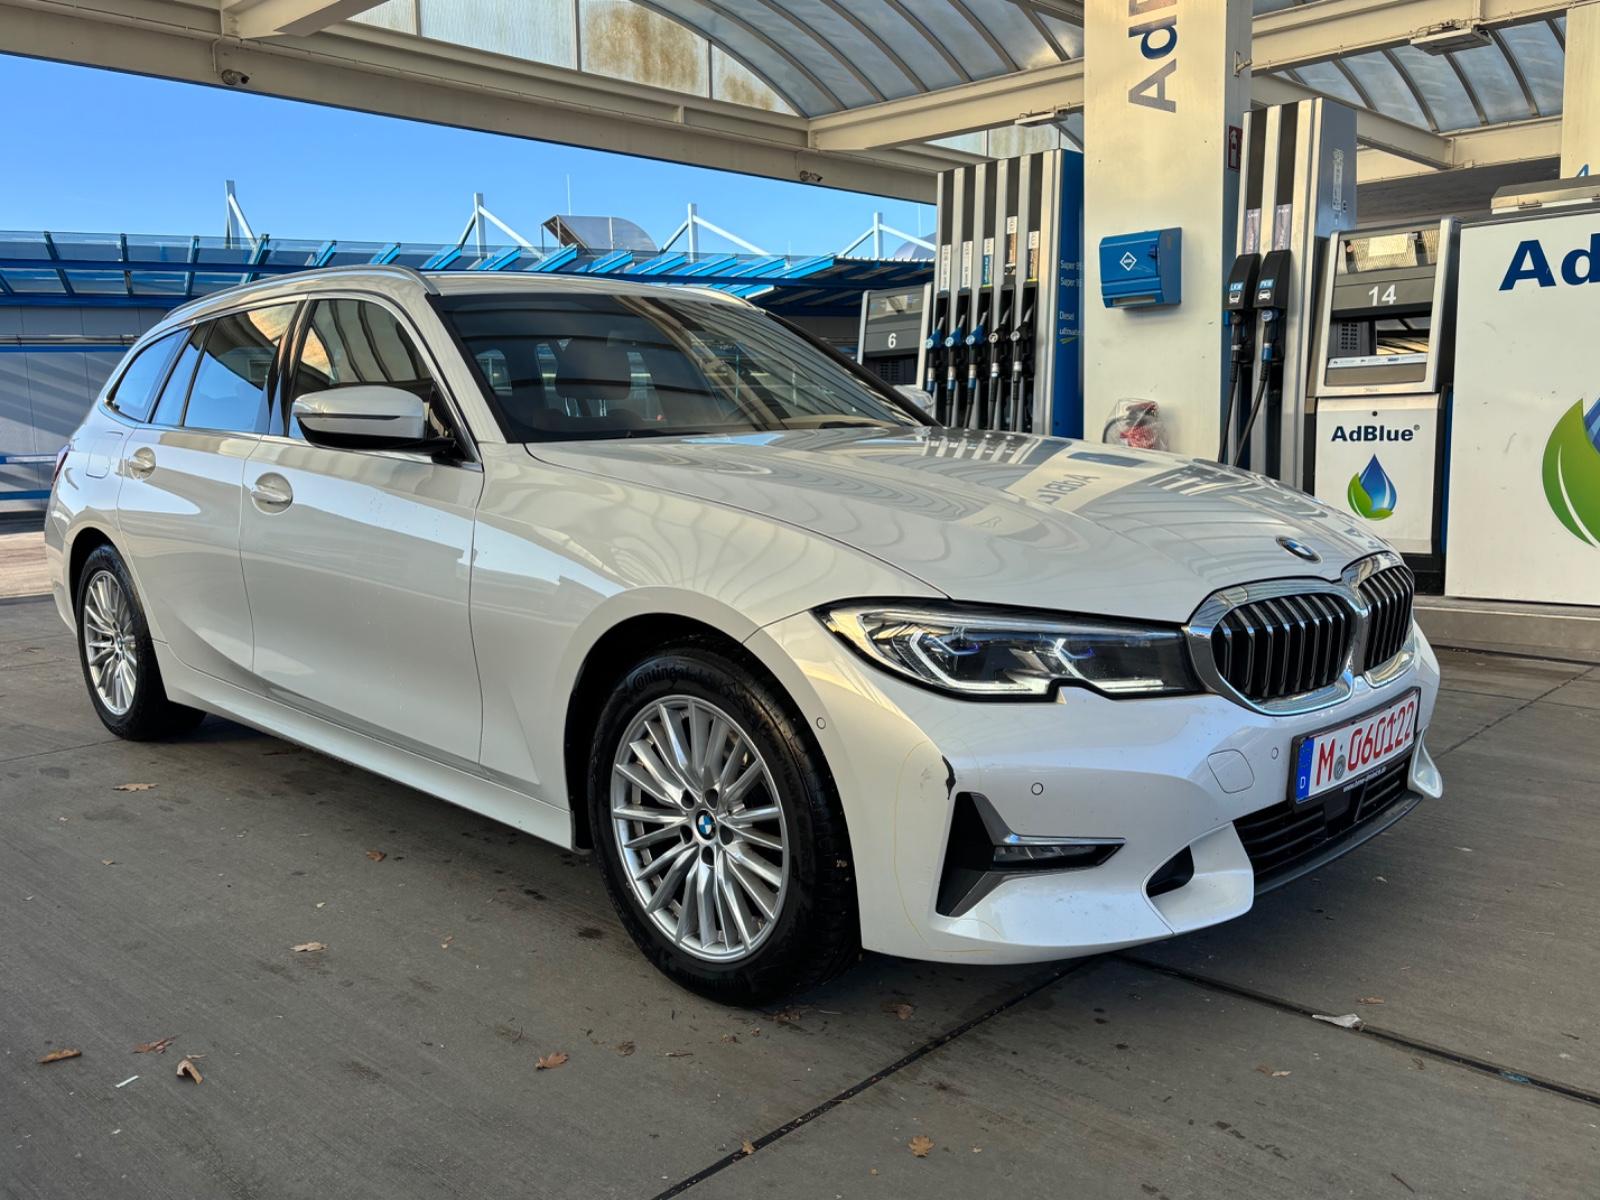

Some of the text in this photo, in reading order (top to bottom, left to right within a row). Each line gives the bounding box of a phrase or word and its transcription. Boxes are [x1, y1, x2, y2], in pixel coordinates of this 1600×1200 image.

[1368, 284, 1397, 307] 14
[888, 332, 897, 349] 6
[1316, 738, 1336, 787] M
[1347, 701, 1415, 772] 060122
[1299, 776, 1306, 789] D
